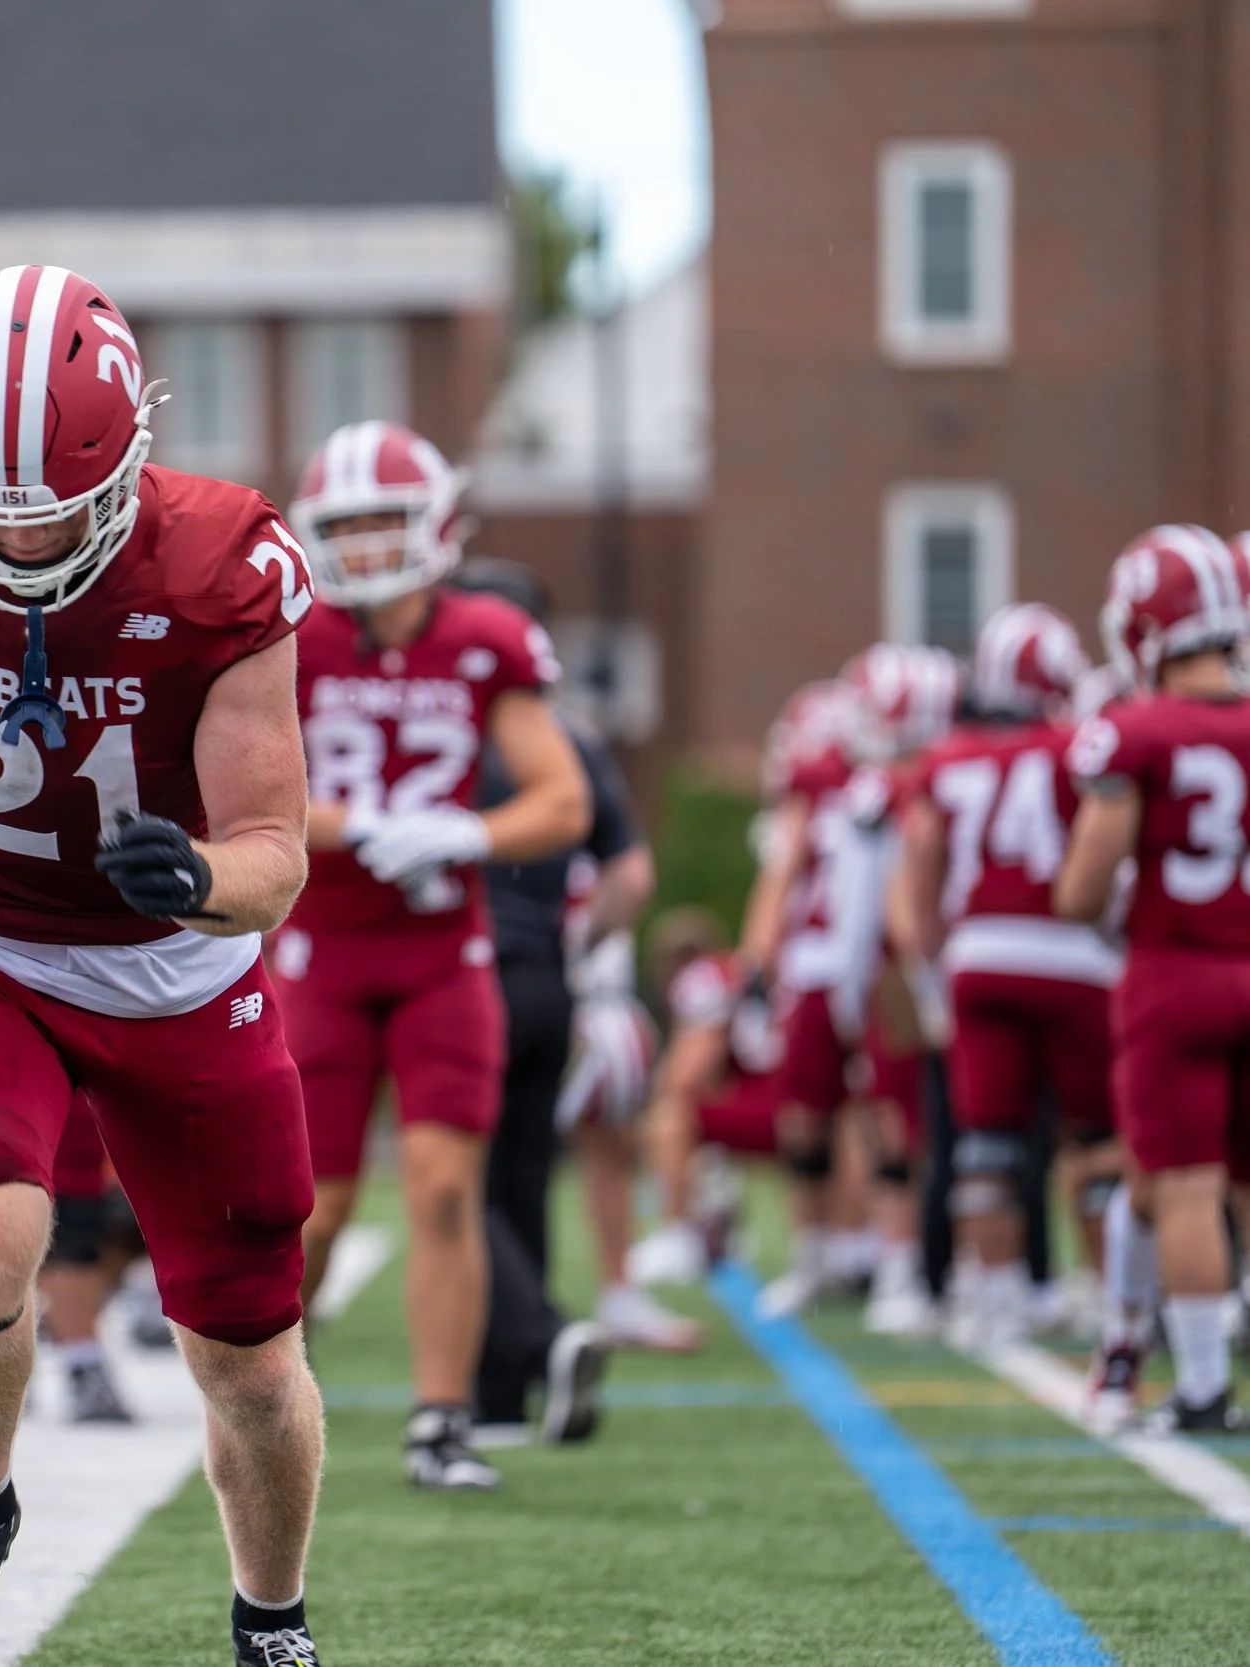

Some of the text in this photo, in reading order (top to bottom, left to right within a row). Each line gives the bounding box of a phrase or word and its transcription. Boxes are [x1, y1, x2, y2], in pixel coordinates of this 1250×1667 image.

[90, 313, 141, 409] 21
[1, 491, 28, 505] 151
[246, 519, 315, 625] 21
[304, 714, 480, 815] 82
[933, 748, 1065, 922] 74
[1161, 743, 1250, 906] 3
